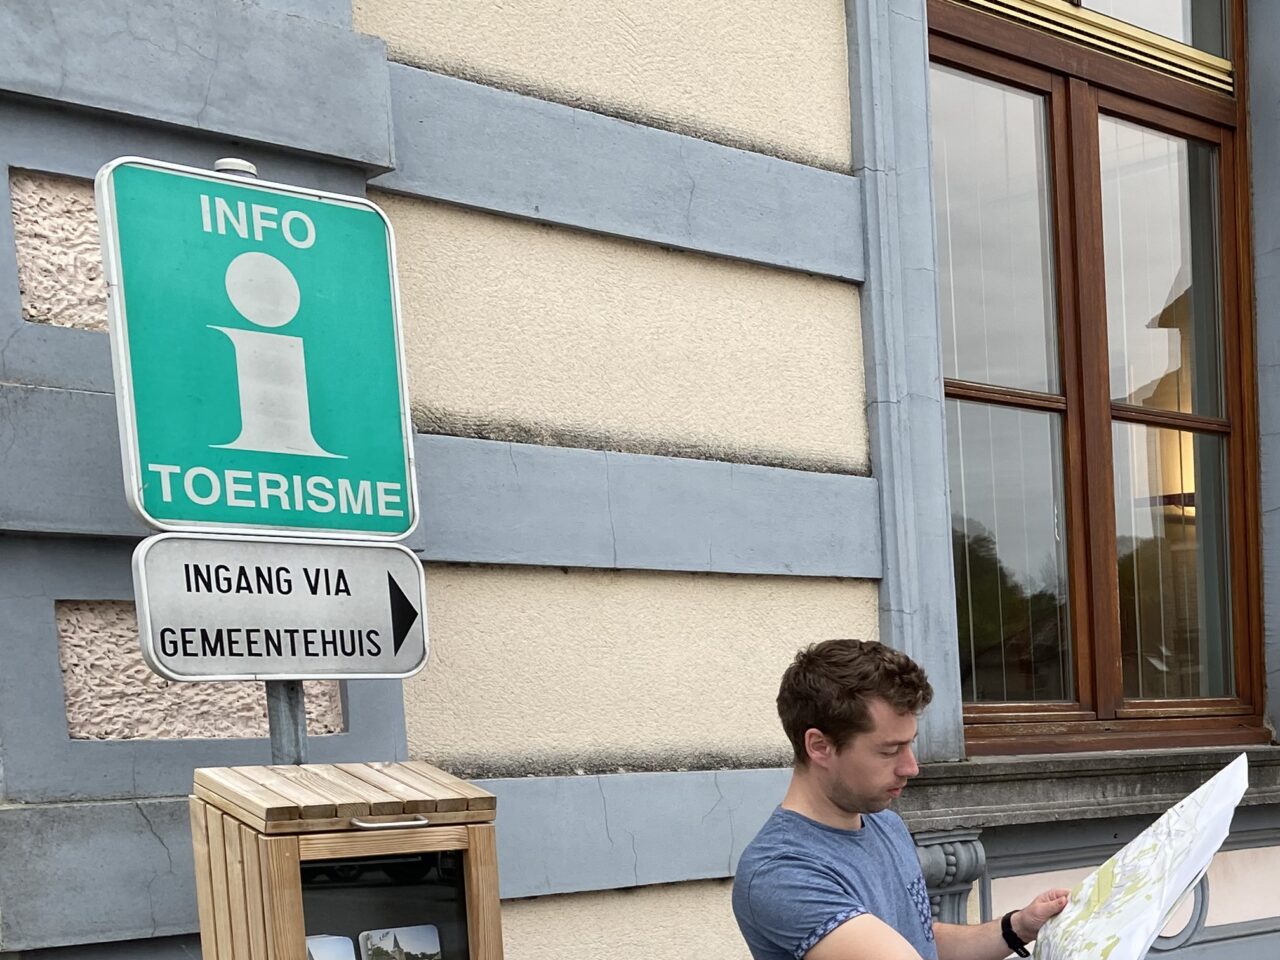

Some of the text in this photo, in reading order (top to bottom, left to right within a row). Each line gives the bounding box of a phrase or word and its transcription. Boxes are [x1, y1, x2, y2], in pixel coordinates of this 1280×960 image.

[199, 194, 317, 249] INFO
[148, 463, 404, 517] TOERISME
[183, 563, 352, 597] INGANG VIA
[158, 626, 382, 659] GEMEENTEHUIS
